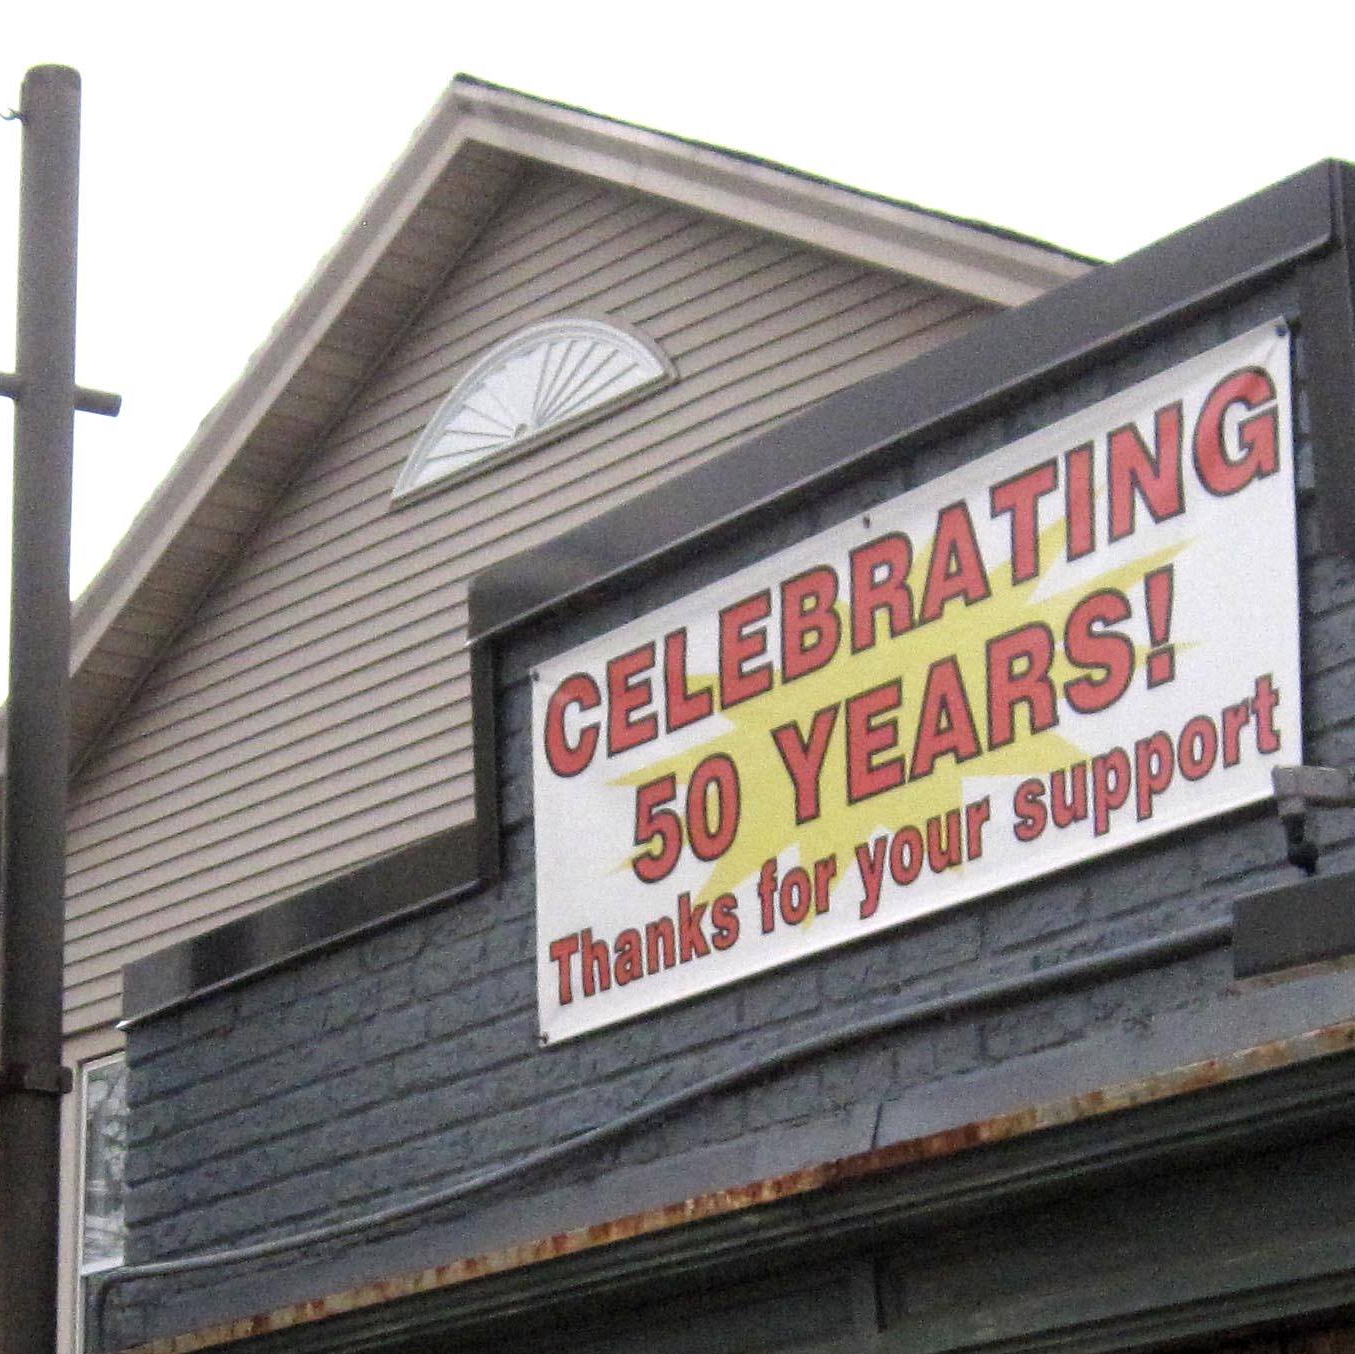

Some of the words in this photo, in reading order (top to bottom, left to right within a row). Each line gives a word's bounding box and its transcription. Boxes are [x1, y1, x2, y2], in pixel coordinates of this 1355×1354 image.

[544, 365, 1281, 778] CELEBRATING
[631, 752, 742, 884] 50
[771, 565, 1176, 826] YEARS!
[549, 893, 739, 1005] Thanks
[757, 850, 838, 934] for
[854, 799, 994, 920] your
[1014, 673, 1281, 842] support
